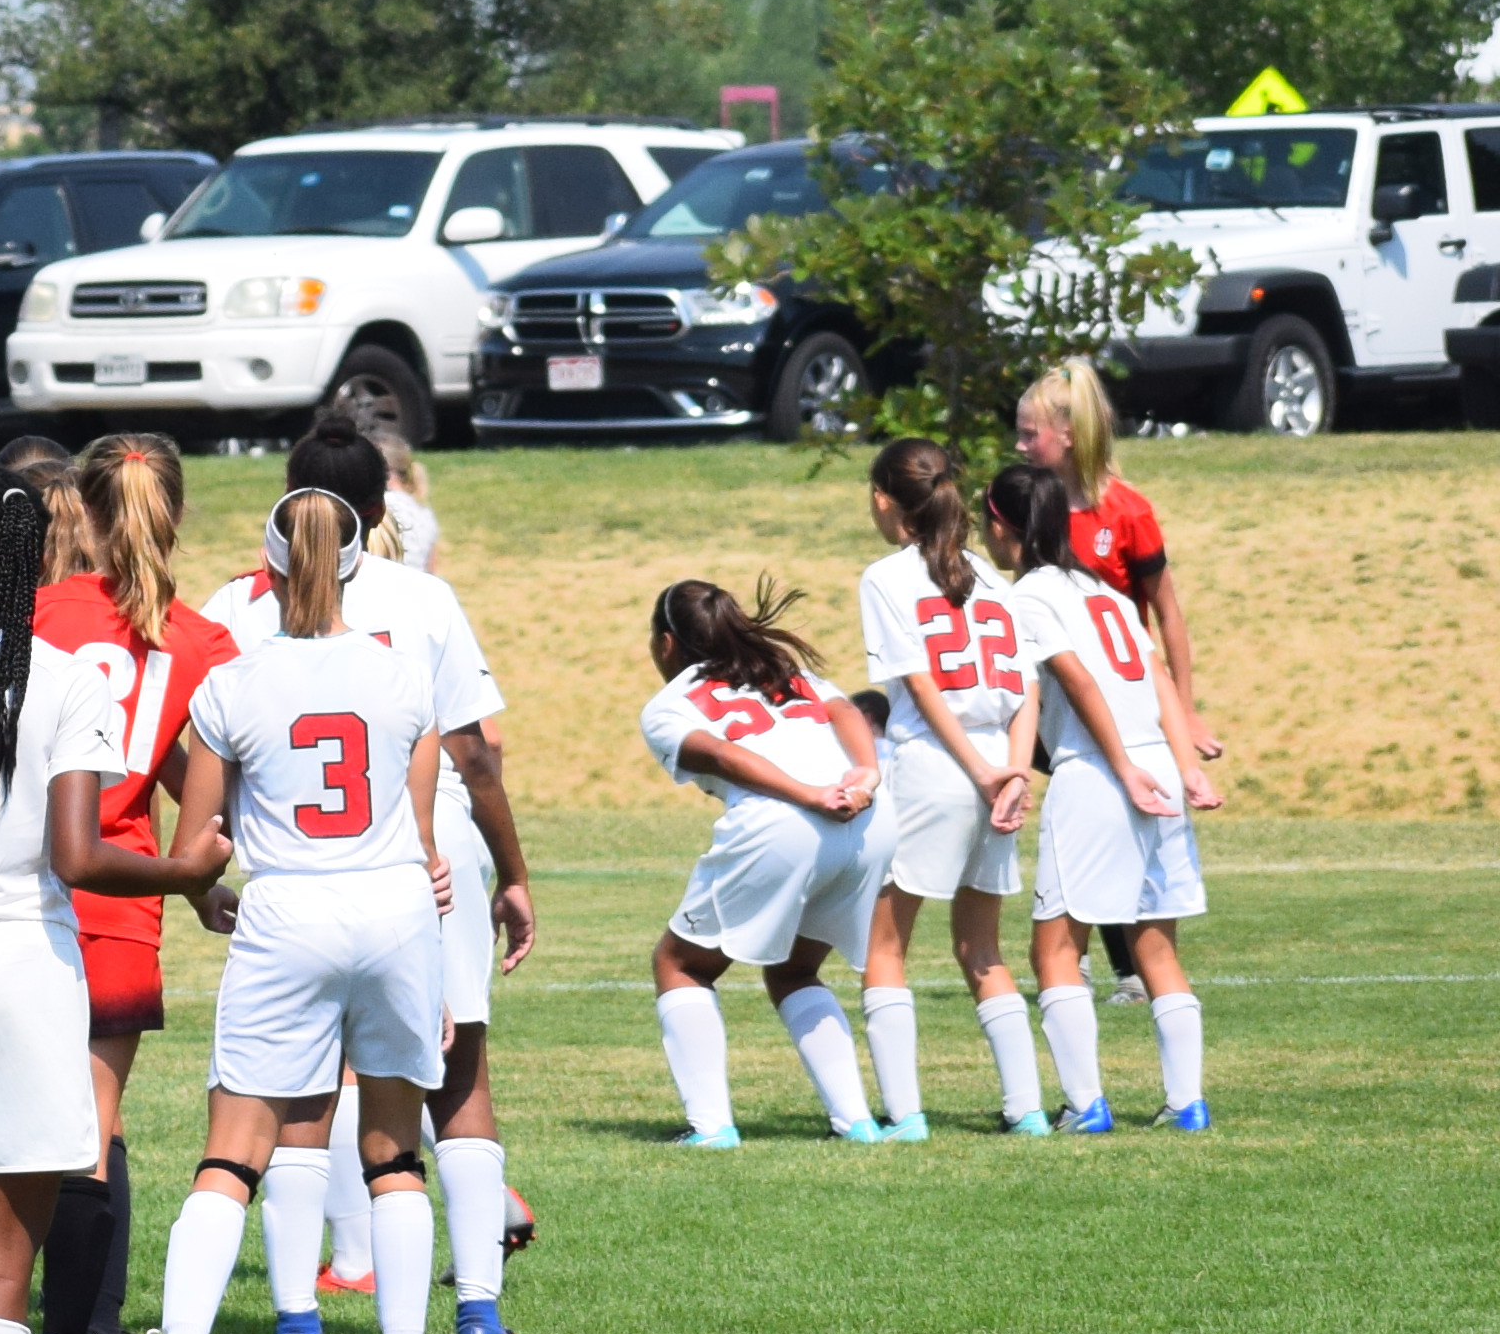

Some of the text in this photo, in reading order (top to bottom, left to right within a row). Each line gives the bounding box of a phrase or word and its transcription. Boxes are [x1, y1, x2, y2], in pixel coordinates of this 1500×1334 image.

[916, 596, 1025, 696] 22
[1084, 594, 1146, 682] 0
[289, 711, 373, 839] 3
